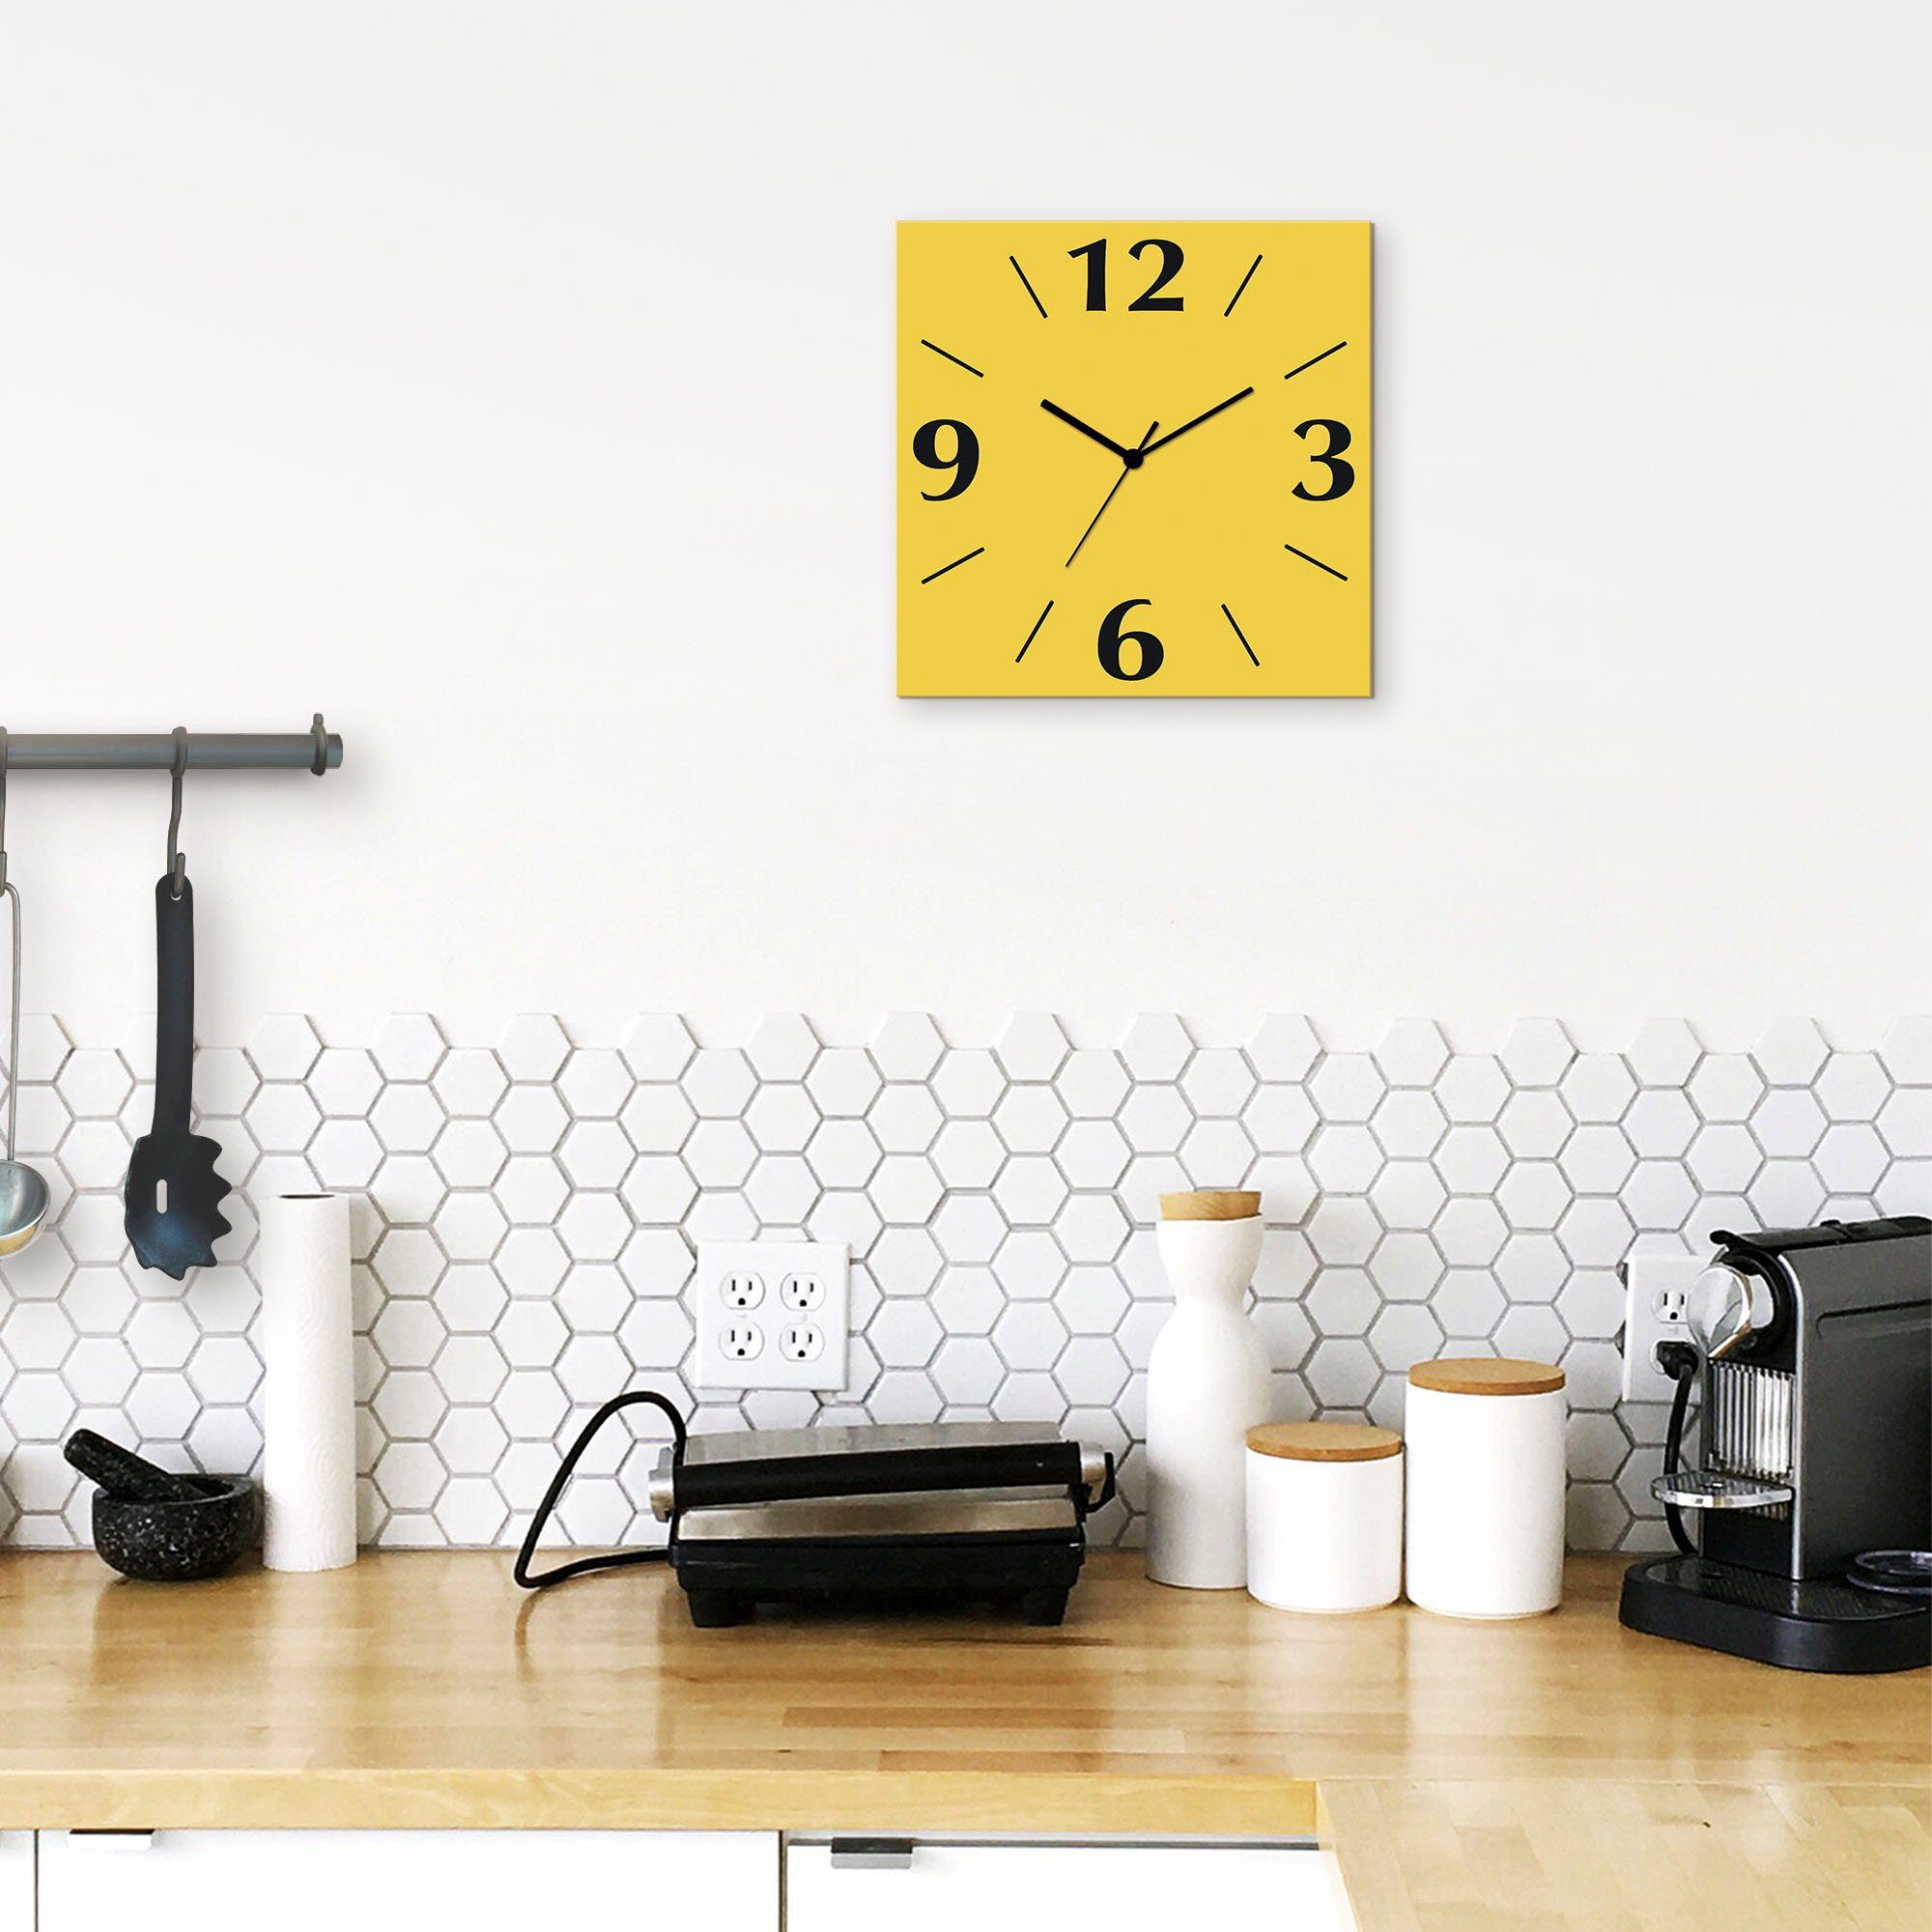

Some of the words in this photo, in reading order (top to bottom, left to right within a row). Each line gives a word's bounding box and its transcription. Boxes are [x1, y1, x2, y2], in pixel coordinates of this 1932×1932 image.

[1066, 238, 1185, 312] 12
[912, 418, 980, 502] 9
[1291, 418, 1355, 502] 3
[1096, 598, 1165, 682] 6
